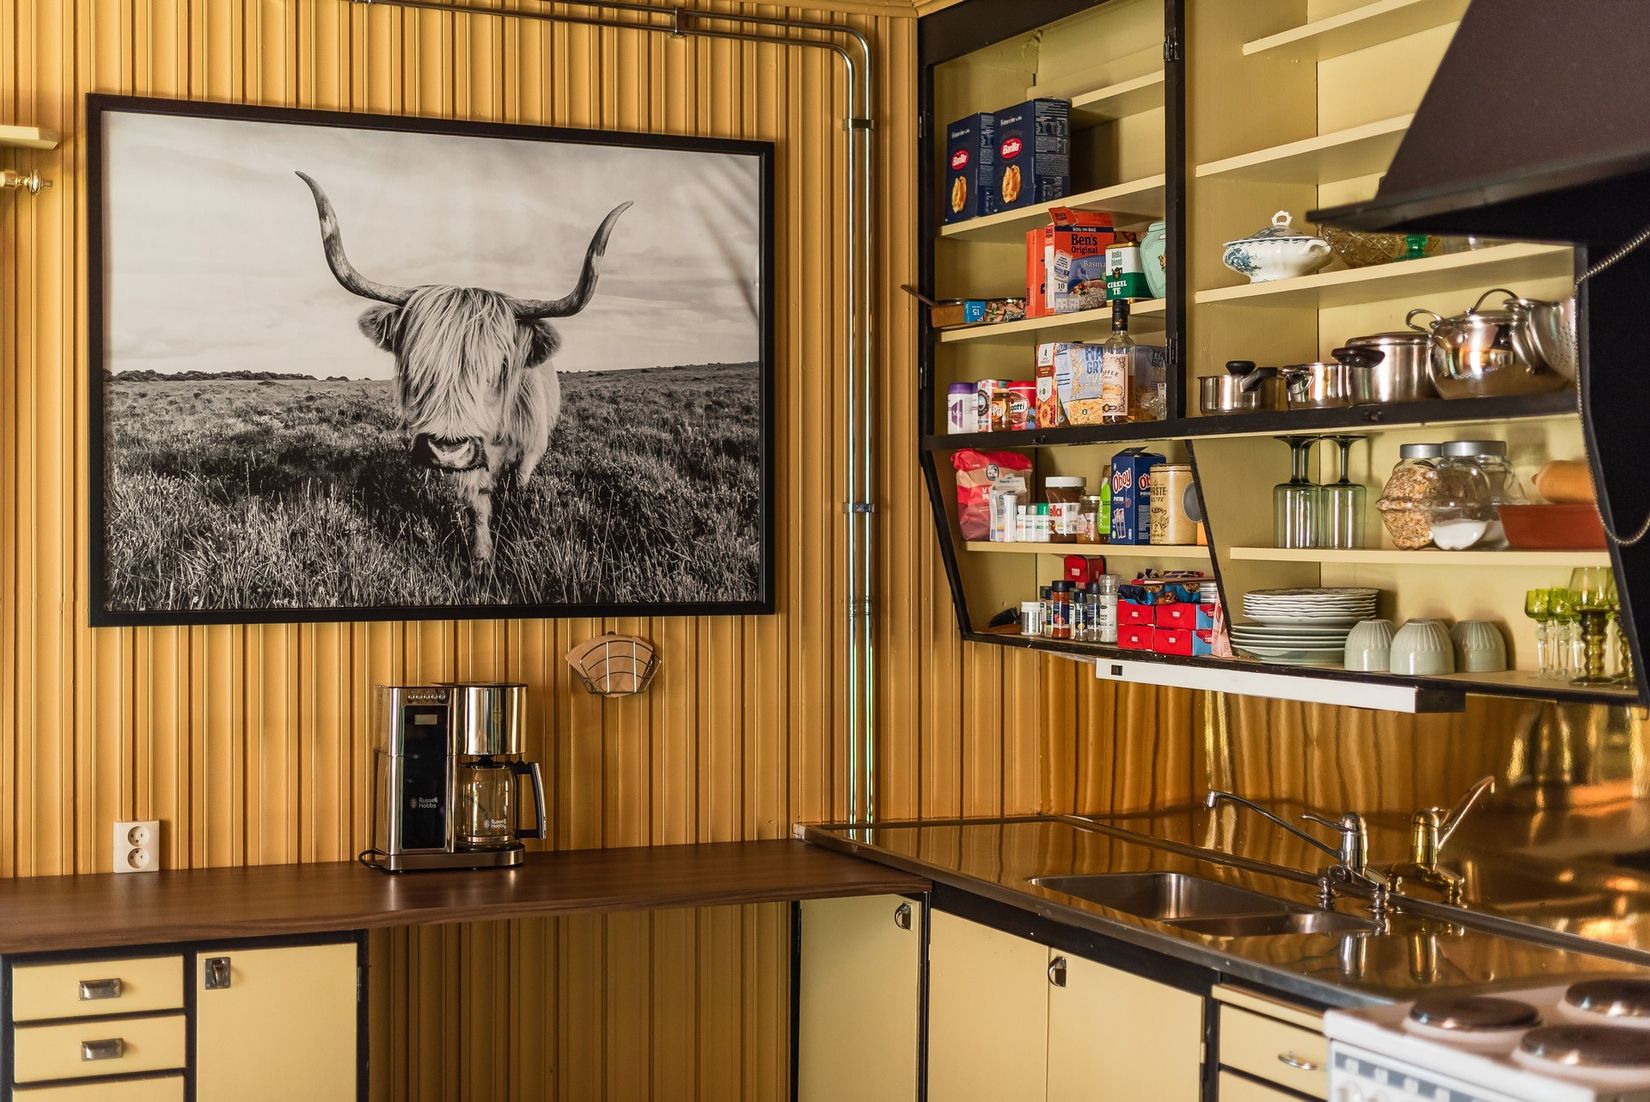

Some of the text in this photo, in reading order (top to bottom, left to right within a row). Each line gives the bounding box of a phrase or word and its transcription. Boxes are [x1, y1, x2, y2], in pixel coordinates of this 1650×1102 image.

[1071, 233, 1098, 246] Ben's
[1071, 246, 1098, 255] Original
[1112, 288, 1122, 296] TE
